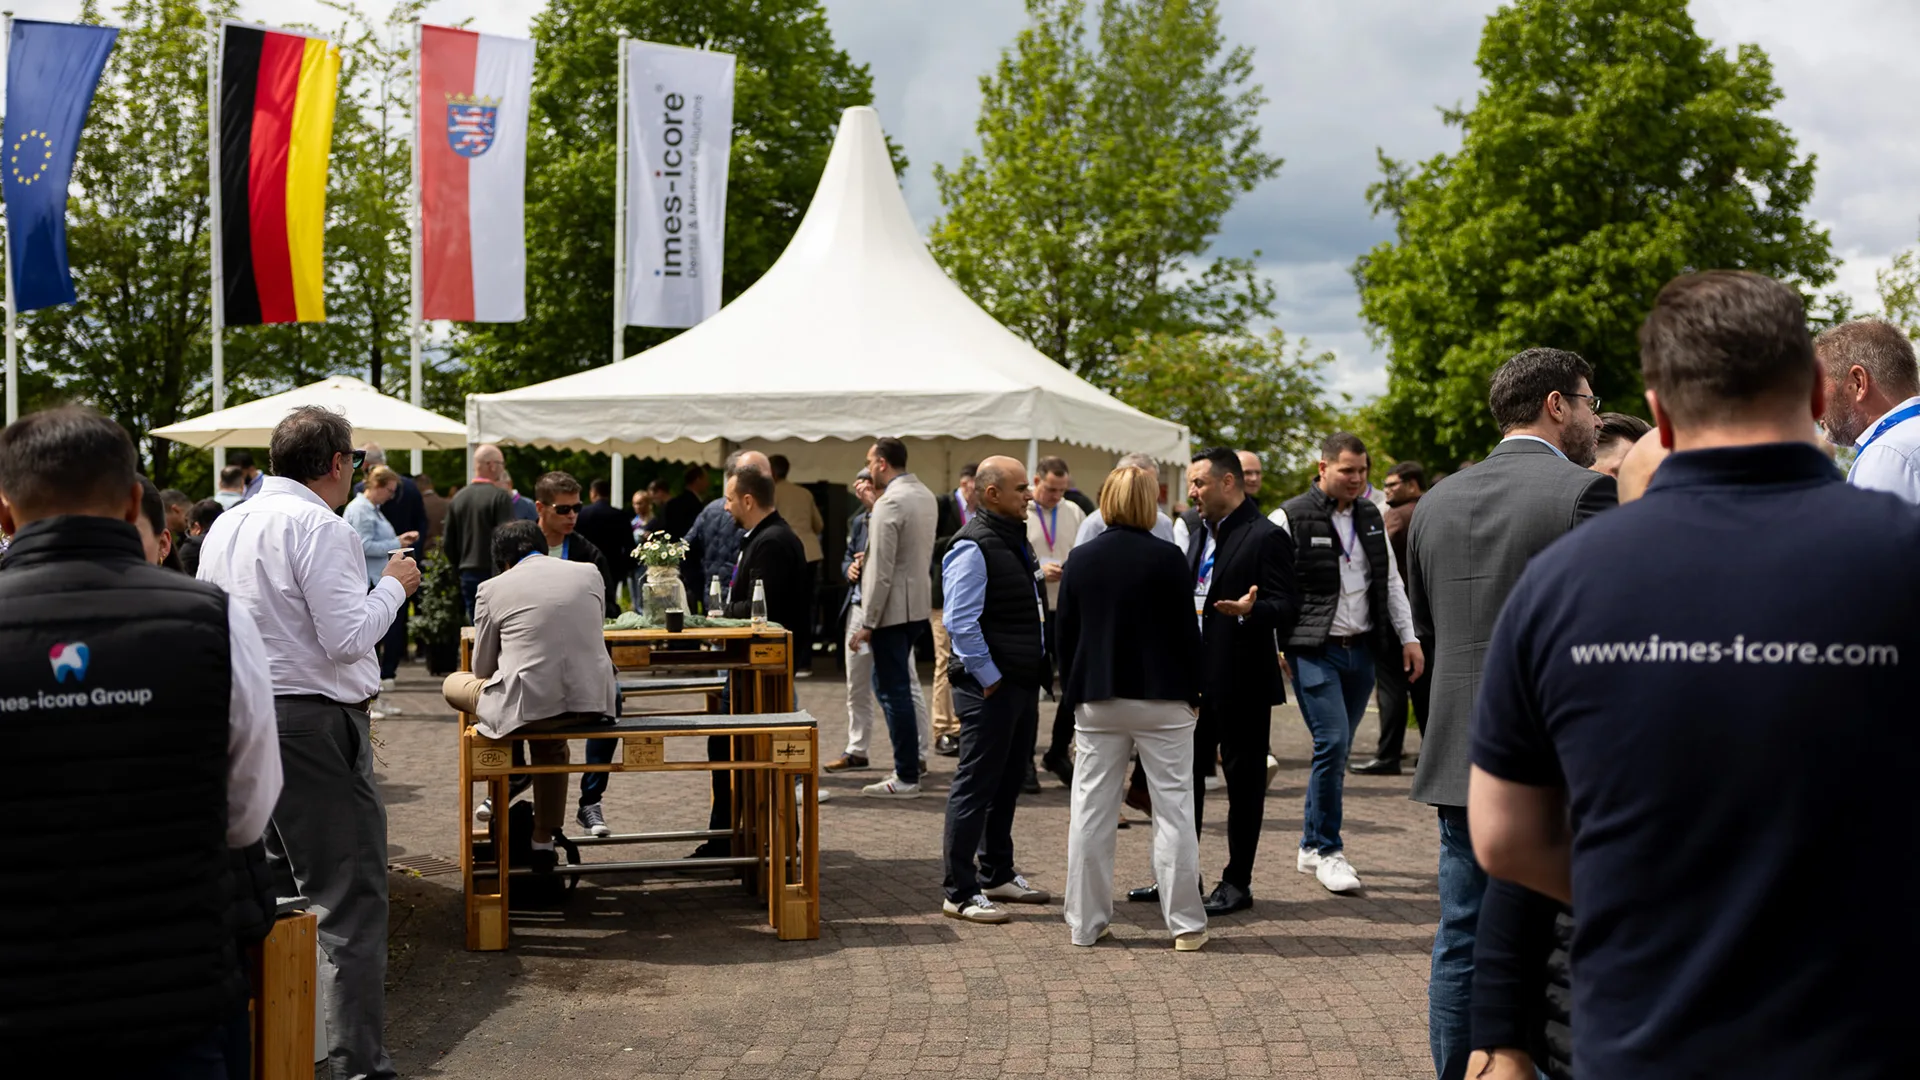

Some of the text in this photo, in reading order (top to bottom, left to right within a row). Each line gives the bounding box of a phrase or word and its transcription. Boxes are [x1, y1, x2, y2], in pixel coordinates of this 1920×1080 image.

[689, 95, 703, 157] Solutions
[655, 92, 685, 276] imes-icore
[688, 221, 699, 230] &
[687, 235, 700, 278] Dental
[1570, 634, 1899, 665] www.imes-icore.com
[90, 687, 153, 706] Group
